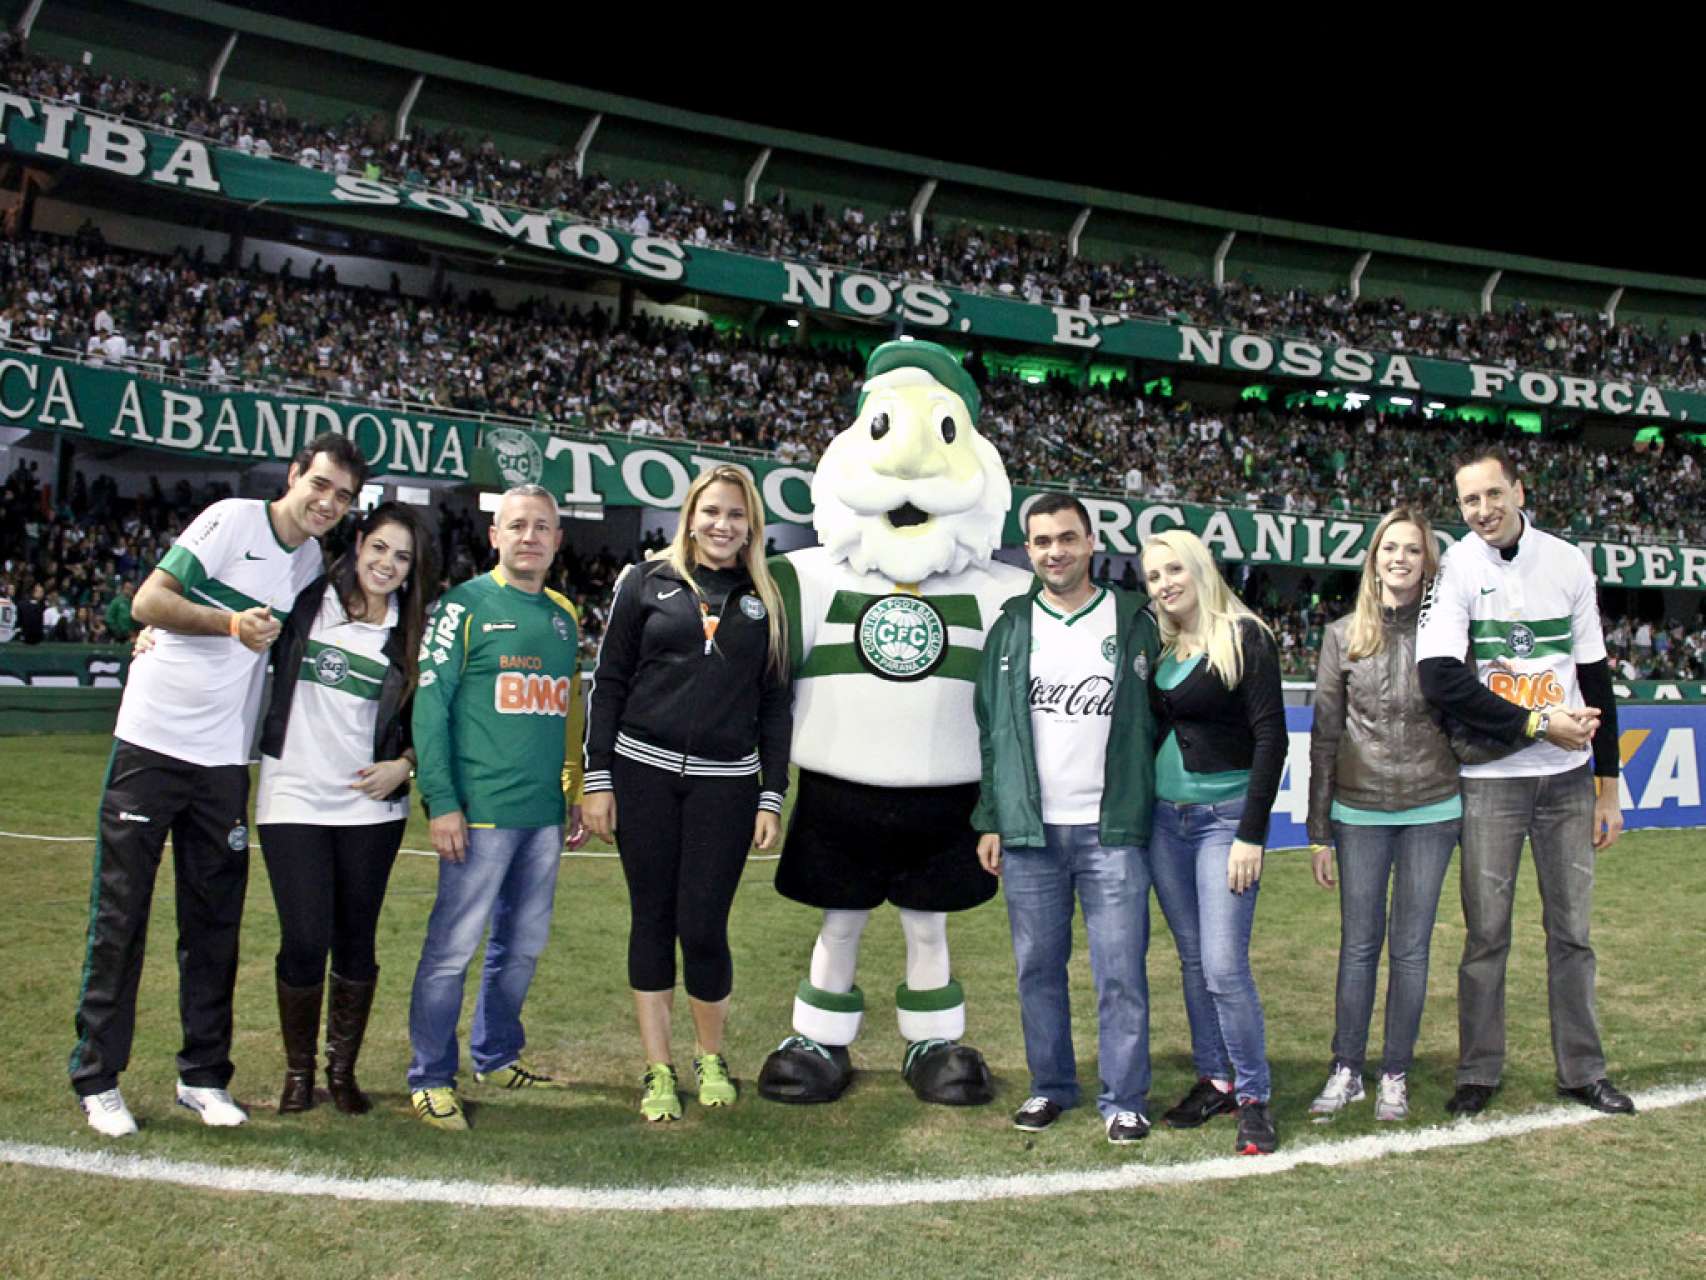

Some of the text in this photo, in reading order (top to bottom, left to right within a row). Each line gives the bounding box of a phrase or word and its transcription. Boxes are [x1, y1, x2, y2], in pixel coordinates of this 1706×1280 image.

[332, 176, 685, 281] SOMOS
[1178, 326, 1420, 389] NOSSA
[0, 358, 84, 430] CA
[109, 379, 468, 479] ABANDONA
[499, 655, 542, 670] BANCO
[879, 624, 926, 646] CFC
